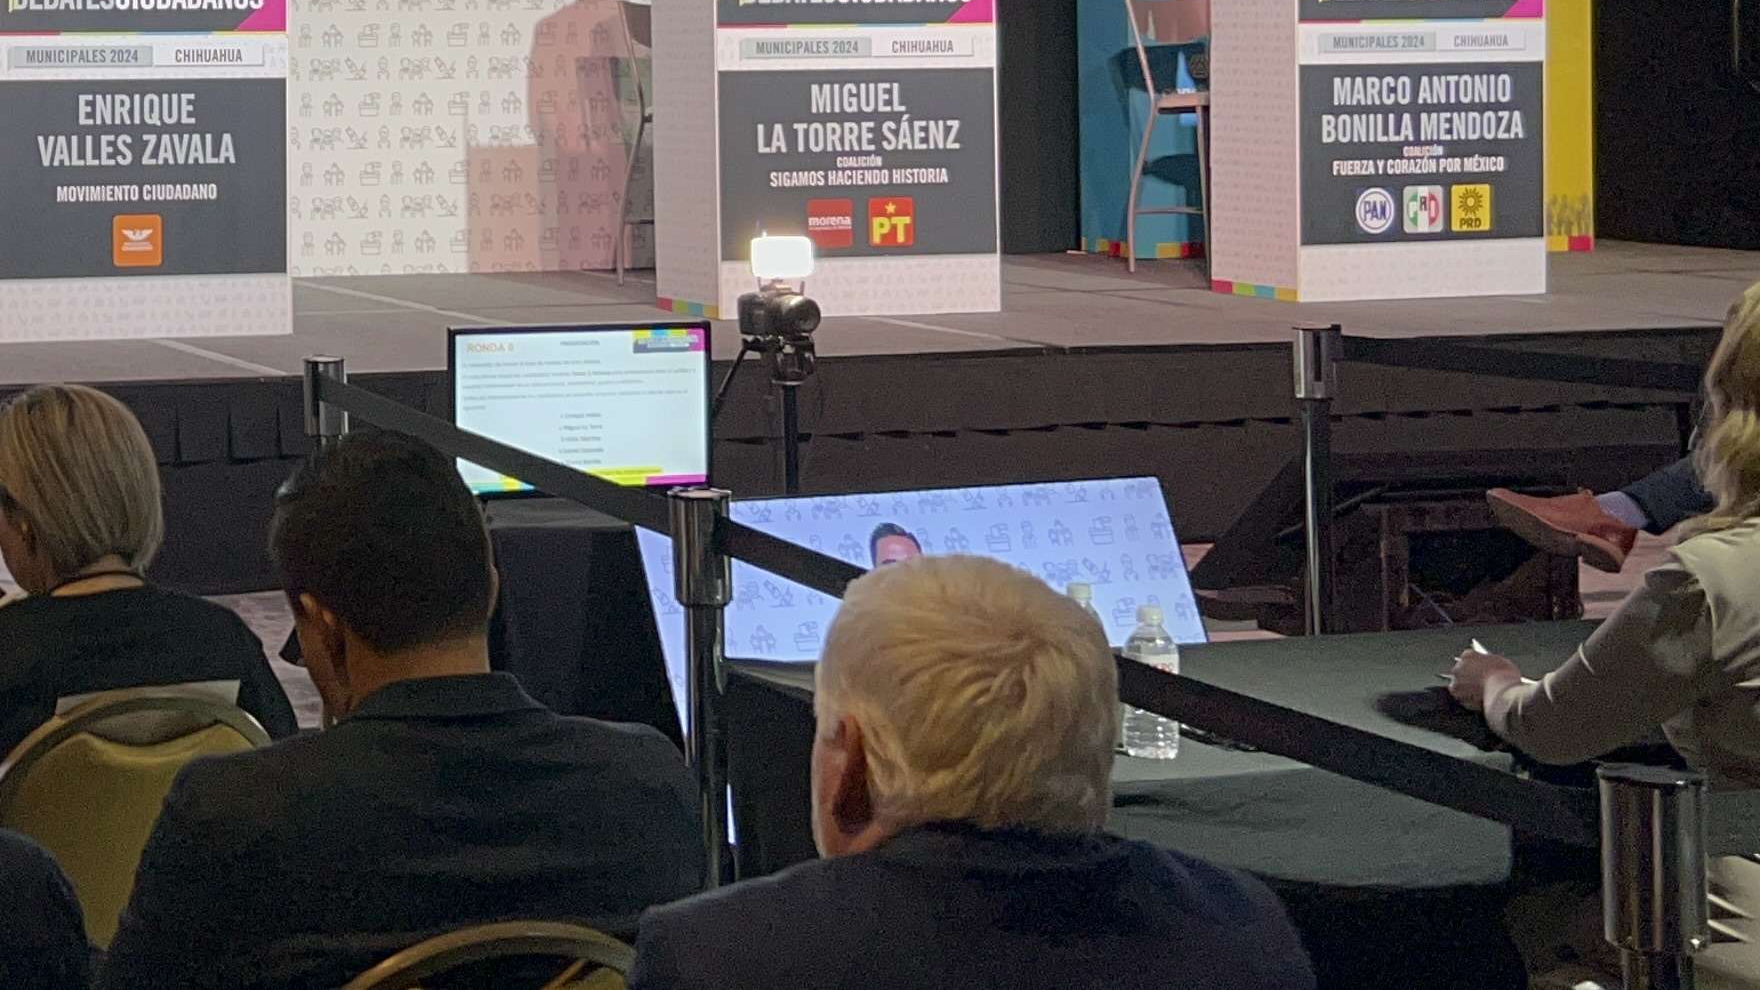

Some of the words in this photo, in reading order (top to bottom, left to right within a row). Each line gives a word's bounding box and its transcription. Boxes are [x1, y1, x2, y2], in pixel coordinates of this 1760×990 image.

[756, 40, 830, 55] MUNICIPALES
[833, 40, 859, 54] 2024
[892, 39, 954, 53] CHIHUAHUA
[1333, 35, 1399, 49] MUNICIPALES
[1401, 35, 1425, 48] 2024
[1454, 34, 1509, 48] CHIHUAHUA
[26, 49, 106, 64] MUNICIPALES
[110, 49, 139, 63] 2024
[175, 48, 243, 63] CHIHUAHUA
[811, 82, 906, 114] MIGUEL
[1333, 75, 1410, 106] MARCO
[1418, 73, 1511, 104] ANTONIO
[78, 93, 196, 127] ENRIQUE
[757, 123, 787, 154] LA
[793, 122, 875, 153] TORRE
[881, 114, 961, 150] SÁENZ
[1321, 112, 1414, 144] BONILLA
[1420, 110, 1524, 141] MENDOZA
[37, 135, 133, 166] VALLES
[141, 133, 236, 165] ZAVALA
[836, 154, 882, 168] COALICIÓN
[1333, 160, 1375, 176] FUERZA
[1377, 159, 1384, 174] Y
[1387, 156, 1437, 175] CORAZÓN
[1439, 158, 1462, 173] POR
[1463, 154, 1505, 172] MÉXICO
[770, 171, 825, 188] SIGAMOS
[828, 169, 889, 186] HACIENDO
[892, 168, 949, 184] HISTORIA
[56, 184, 139, 202] MOVIMIENTO
[142, 183, 217, 200] CIUDADANO
[1363, 200, 1387, 222] PAN
[808, 216, 852, 227] morena
[872, 216, 911, 244] PT
[1459, 217, 1482, 229] PRD
